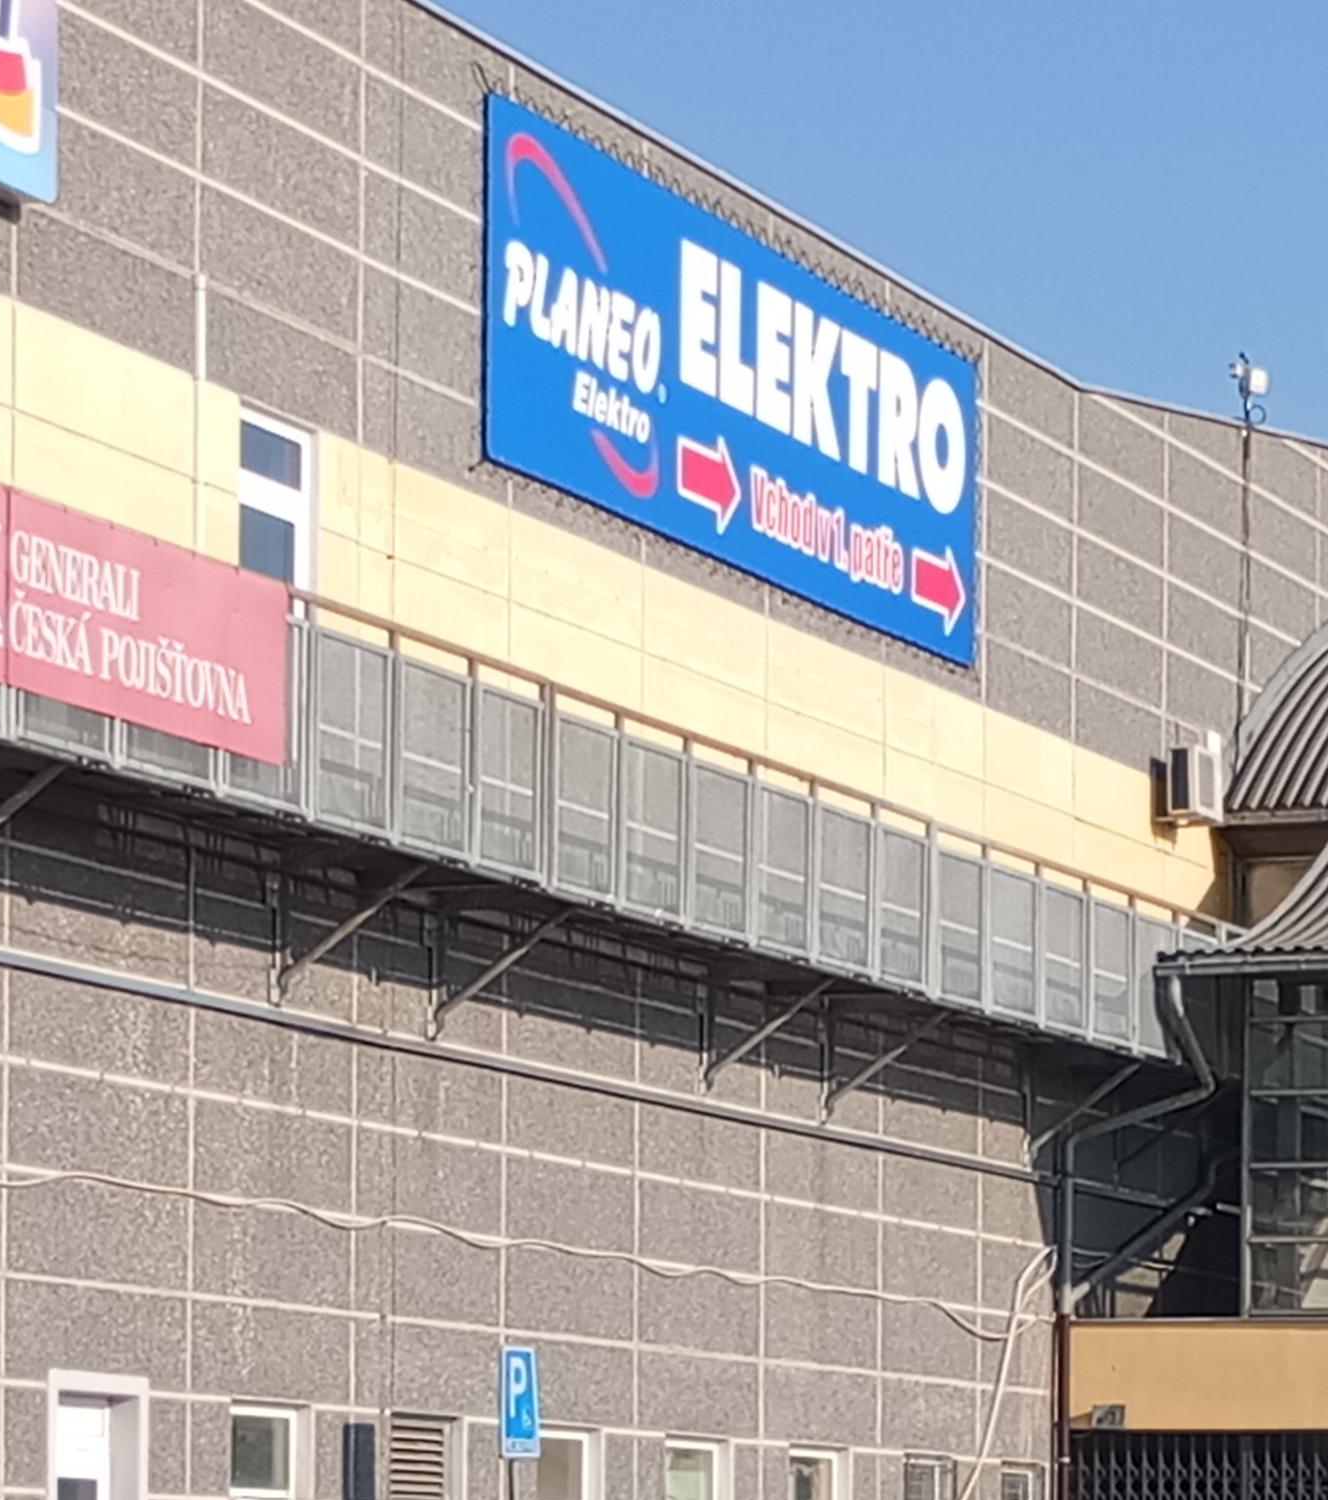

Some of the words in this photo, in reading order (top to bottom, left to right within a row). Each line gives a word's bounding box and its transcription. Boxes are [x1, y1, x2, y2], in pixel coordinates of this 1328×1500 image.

[503, 239, 661, 395] PLANEO
[571, 369, 651, 444] Elektro
[678, 238, 967, 515] ELEKTRO
[10, 529, 142, 622] GENERALI
[9, 588, 94, 676] ČESKÁ
[99, 626, 253, 725] POJIŠŤOVNA
[509, 1356, 528, 1419] P
